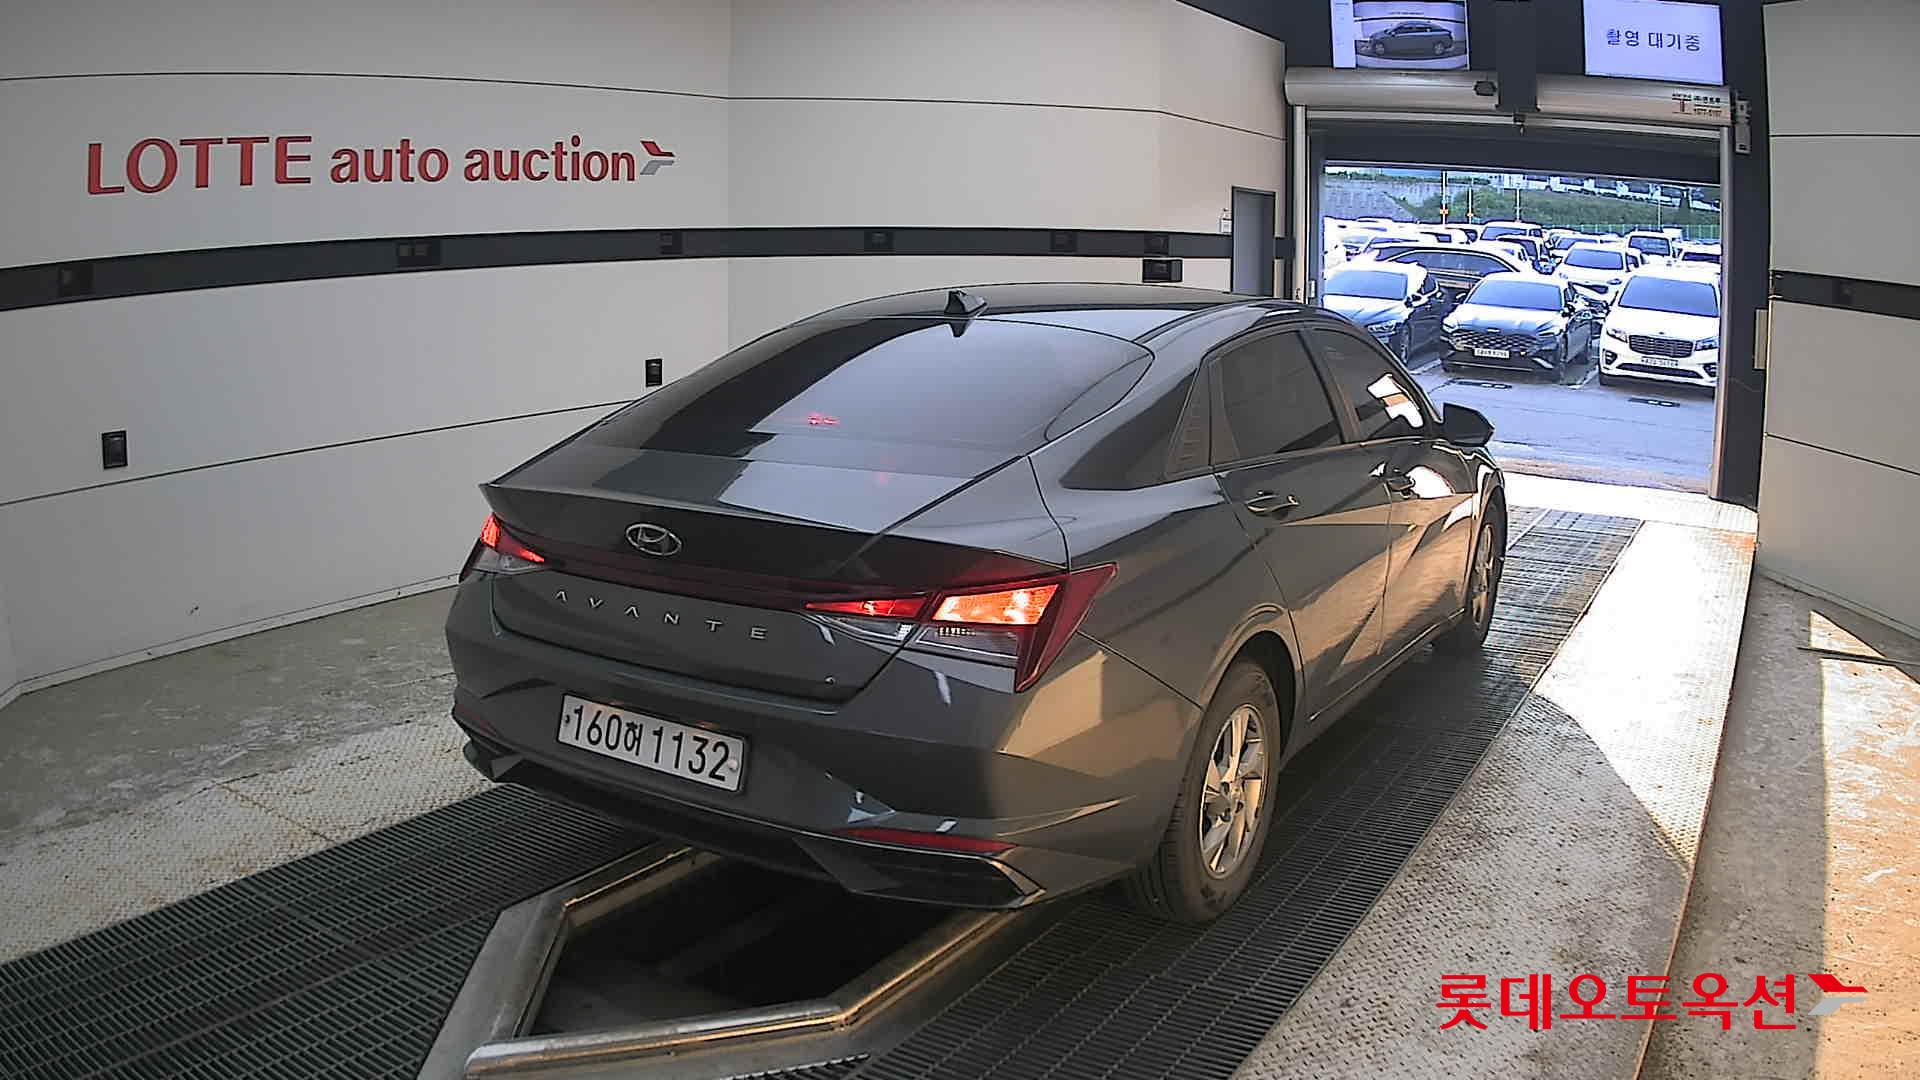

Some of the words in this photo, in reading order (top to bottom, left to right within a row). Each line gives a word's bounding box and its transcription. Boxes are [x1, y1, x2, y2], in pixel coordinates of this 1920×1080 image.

[1648, 32, 1701, 52] 대기중
[87, 135, 312, 195] LOTTE
[330, 139, 449, 183] auto
[464, 135, 636, 183] auction
[554, 590, 768, 640] AVANTE
